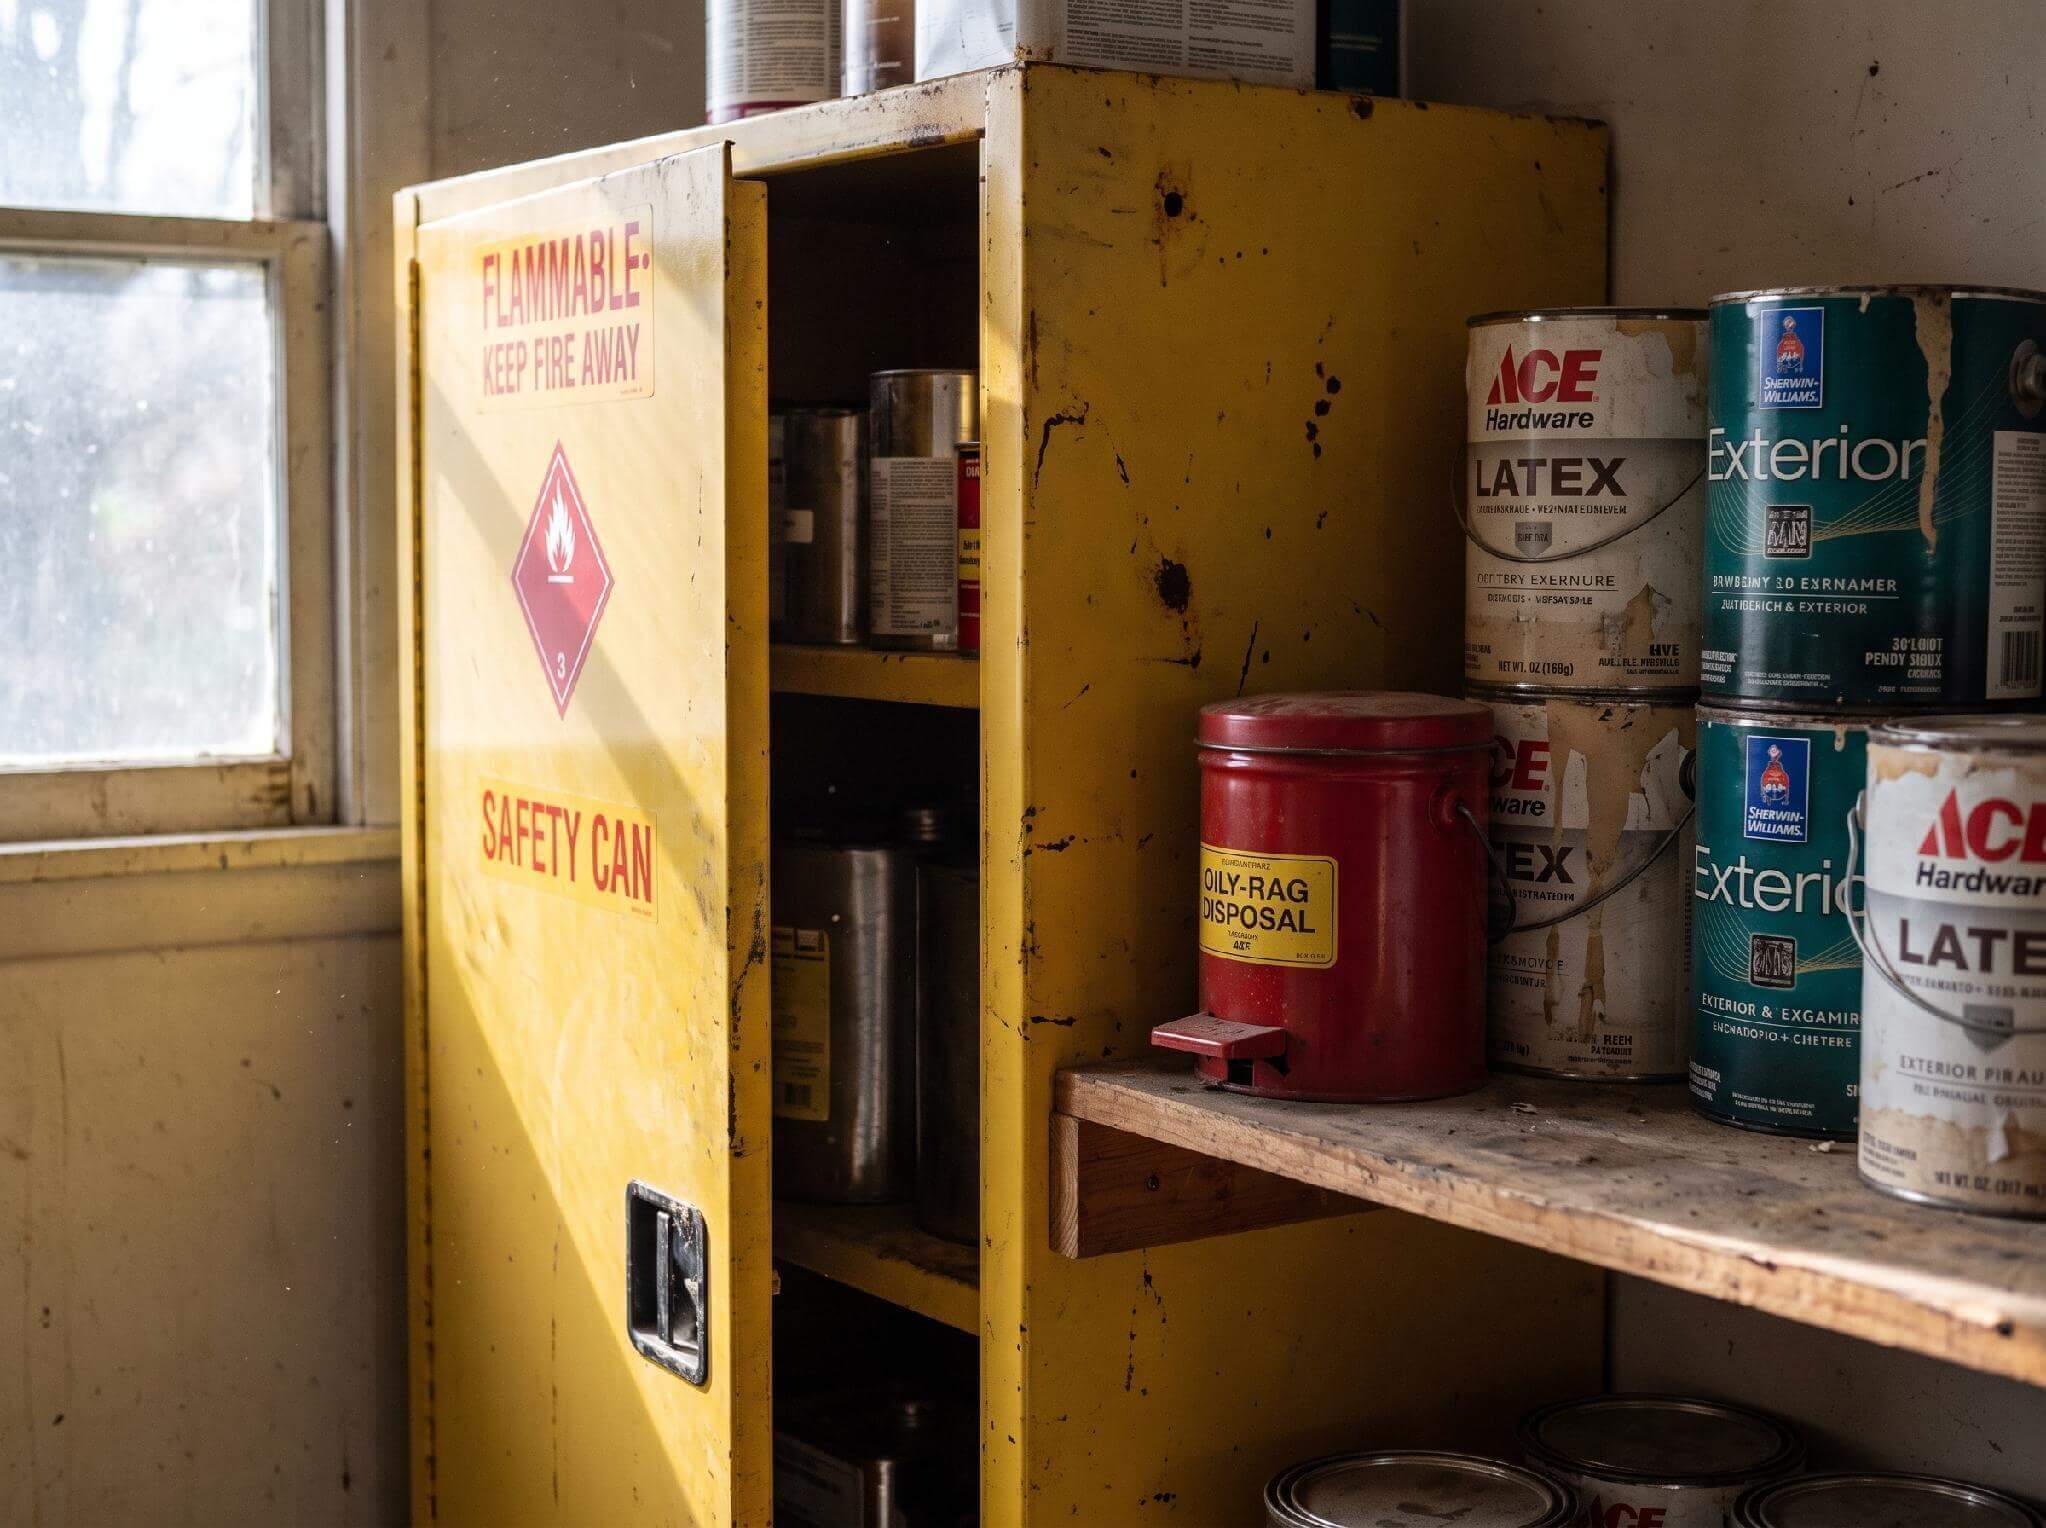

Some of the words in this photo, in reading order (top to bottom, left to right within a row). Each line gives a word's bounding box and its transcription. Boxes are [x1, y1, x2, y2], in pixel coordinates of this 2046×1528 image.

[483, 221, 640, 331] FLAMMABLE
[484, 340, 527, 396] KEEP
[534, 332, 576, 391] FIRE
[582, 323, 640, 386] AWAY
[1487, 342, 1603, 406] ACE
[1486, 408, 1594, 431] Hardware
[1708, 424, 1927, 481] Exterior
[1476, 457, 1628, 497] LATEX
[1799, 601, 1868, 615] EXTERIOR
[556, 651, 567, 679] 3
[1489, 735, 1550, 791] CE
[1492, 797, 1547, 816] ware
[1748, 806, 1804, 821] SHERWIN-
[481, 788, 581, 882] SAFETY
[591, 812, 652, 904] CAN
[1204, 867, 1309, 904] OILY-RAG
[1695, 844, 1865, 918] Exterio
[1203, 896, 1316, 934] DISPOSAL
[1702, 993, 1756, 1017] EXTERIOR
[1761, 1005, 1773, 1019] &
[1782, 1008, 1864, 1025] EXGAMIR
[1899, 1054, 1977, 1081] EXTERIOR
